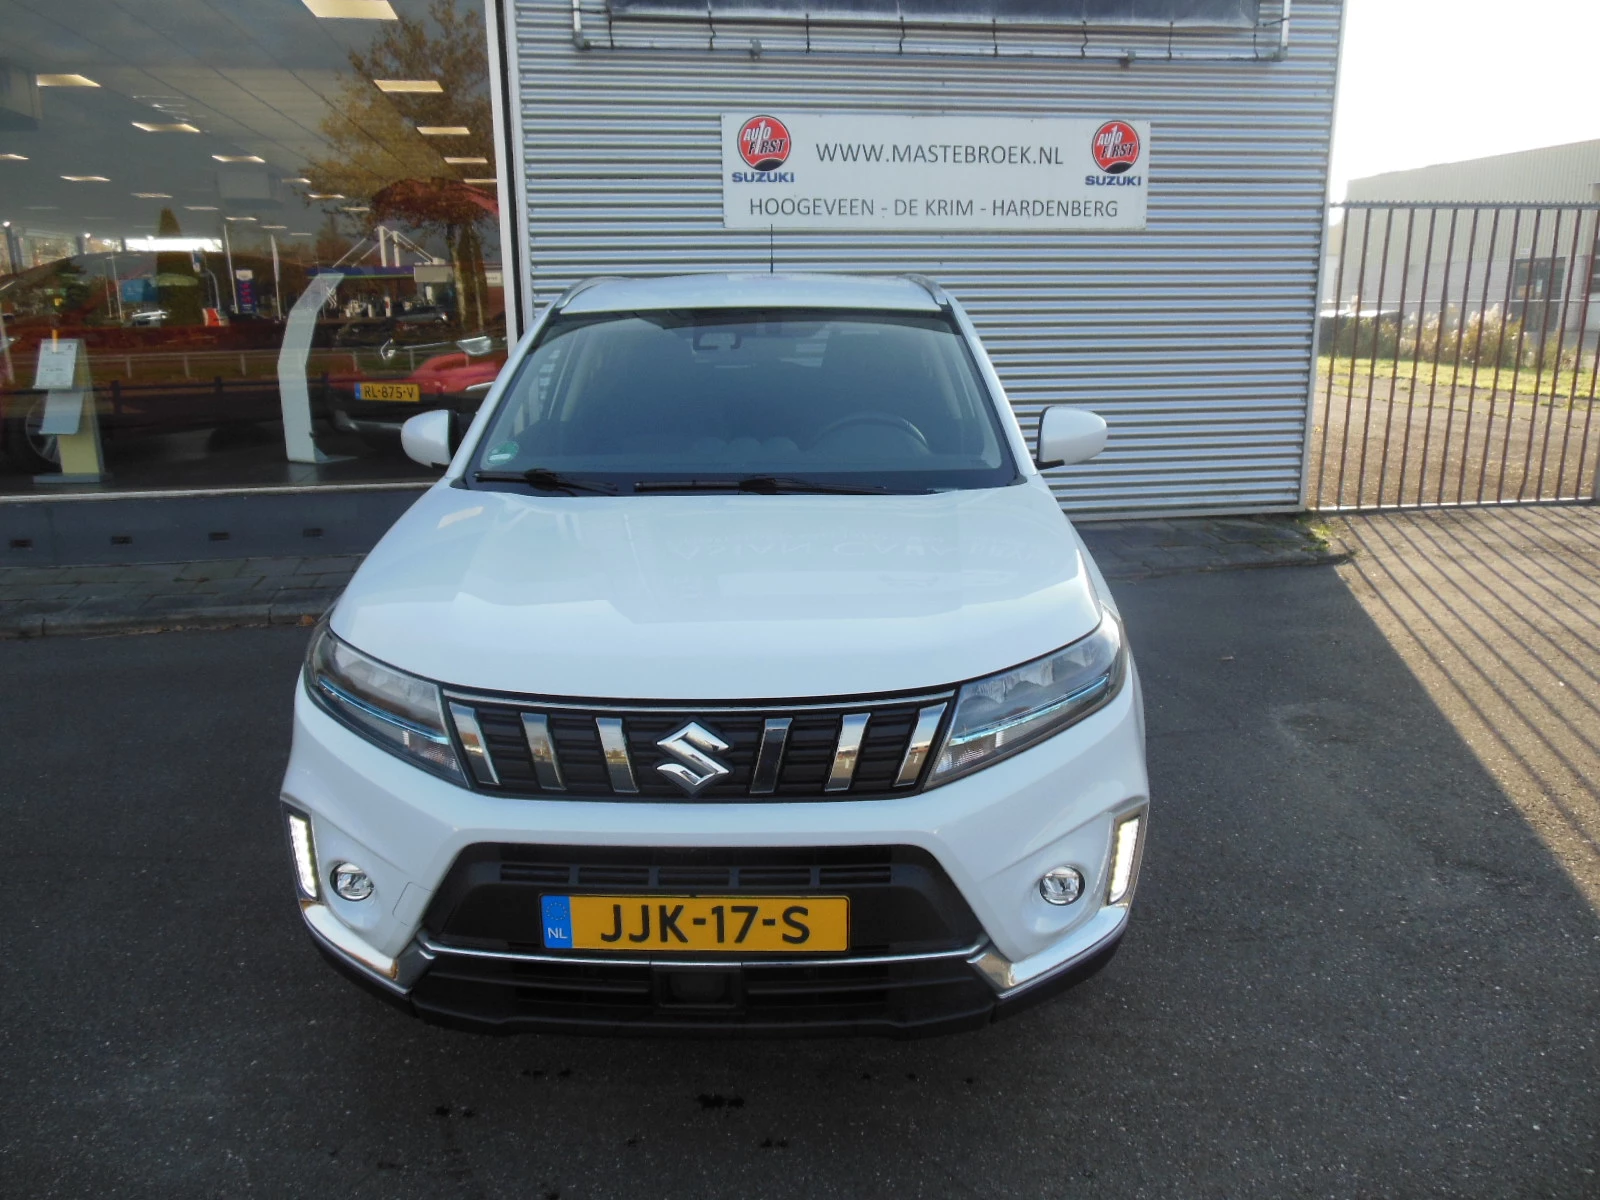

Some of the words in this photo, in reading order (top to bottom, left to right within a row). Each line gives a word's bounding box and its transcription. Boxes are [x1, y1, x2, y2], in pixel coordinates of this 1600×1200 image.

[815, 142, 1064, 166] WWW.MASTEBROEK.NL
[732, 171, 795, 183] SUZUKI
[1085, 175, 1142, 187] SUZUKI
[749, 198, 875, 217] HOOGEVEEN
[894, 199, 919, 217] DE
[925, 199, 974, 217] KRIM
[992, 199, 1119, 218] HARDENBERG
[548, 926, 568, 939] NL
[600, 903, 811, 945] JJK-17-S
